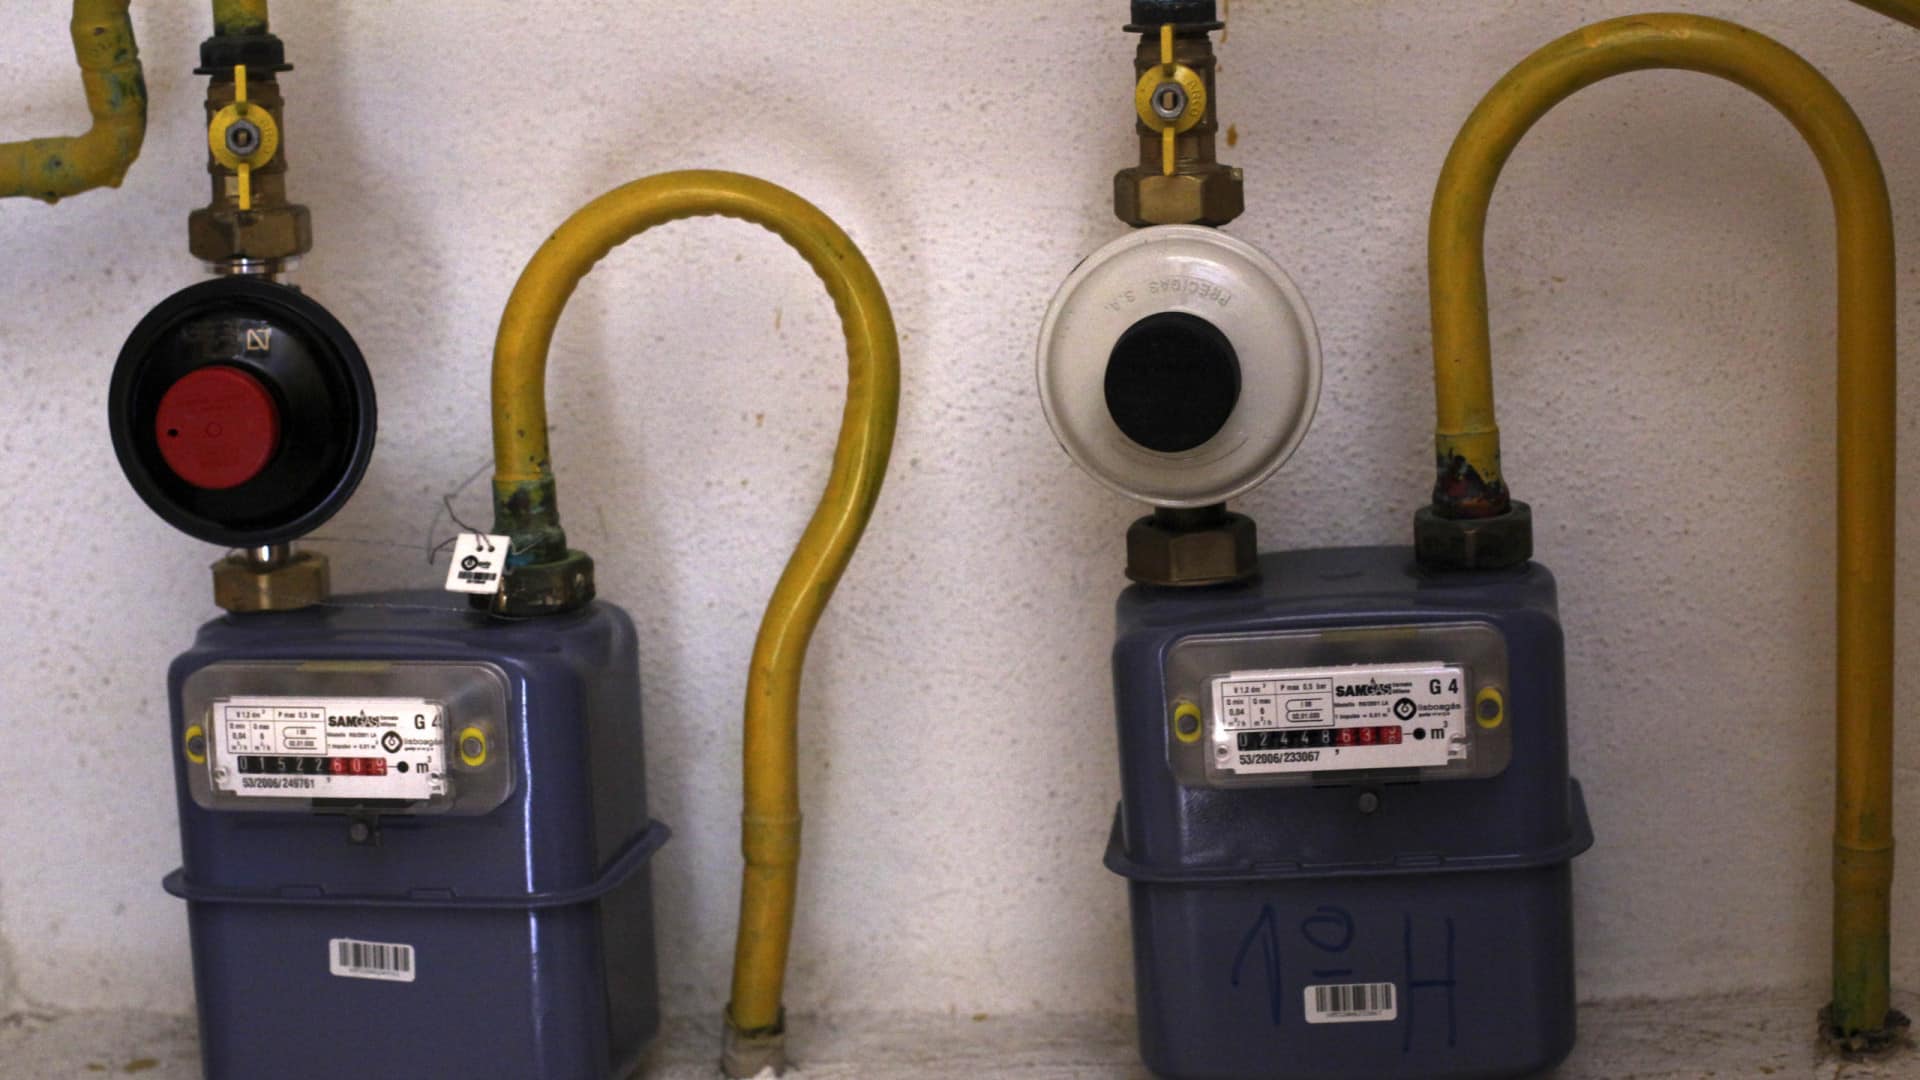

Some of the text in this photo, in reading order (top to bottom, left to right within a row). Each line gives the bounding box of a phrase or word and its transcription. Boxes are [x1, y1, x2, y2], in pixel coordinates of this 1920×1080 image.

[1149, 280, 1231, 307] PRECIGAS
[1336, 683, 1392, 697] SAMGAS
[1429, 678, 1458, 695] G 4
[328, 715, 379, 727] SAMGAS
[414, 714, 425, 730] G
[1431, 720, 1448, 739] m³
[1239, 750, 1320, 765] 53/2006/233067
[1403, 911, 1457, 1053] H
